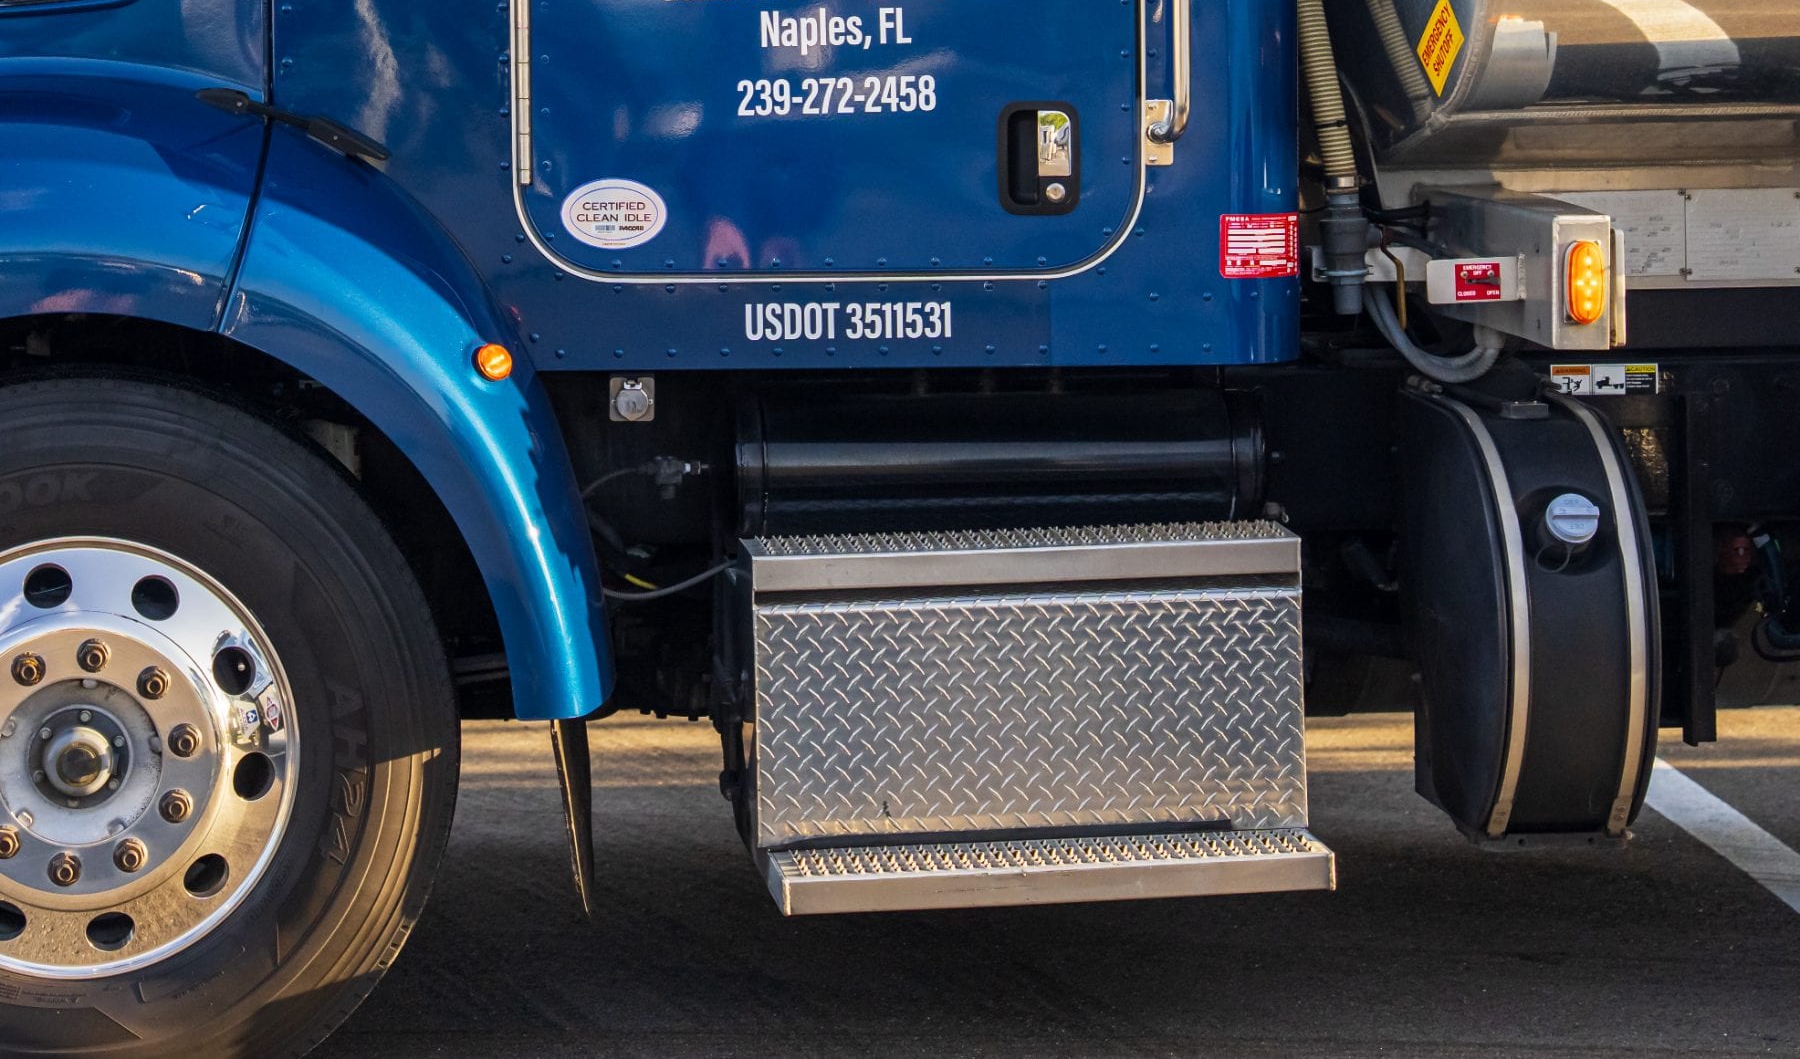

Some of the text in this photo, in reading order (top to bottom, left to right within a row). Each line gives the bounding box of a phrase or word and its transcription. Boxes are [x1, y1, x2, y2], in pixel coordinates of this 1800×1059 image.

[760, 7, 913, 56] Naples, FL
[1422, 2, 1451, 67] EMERGENCY
[1433, 28, 1454, 77] SHUTOFF
[736, 75, 937, 117] 239-272-2458
[576, 214, 652, 222] CLEAN IDLE
[582, 202, 646, 211] CERTIFIED
[745, 301, 952, 341] USDOT 3511531
